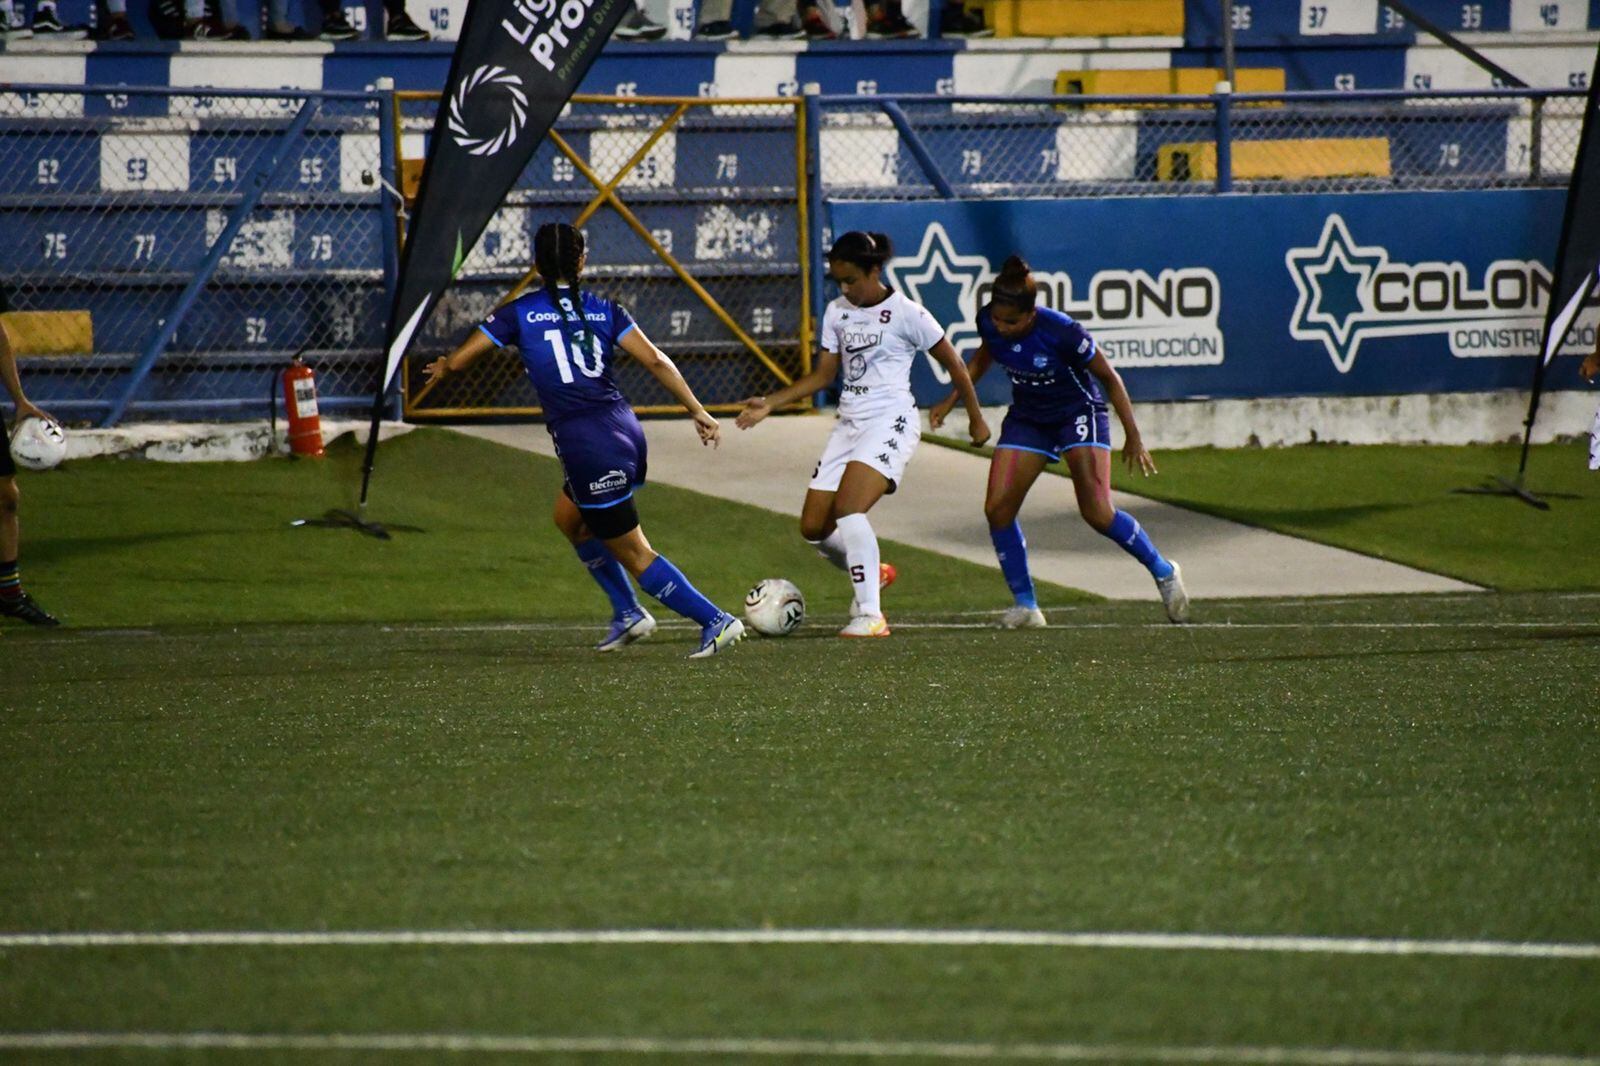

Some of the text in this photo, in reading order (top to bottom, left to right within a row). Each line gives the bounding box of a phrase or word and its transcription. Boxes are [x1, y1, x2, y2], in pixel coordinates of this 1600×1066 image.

[529, 0, 595, 72] Pro
[1308, 6, 1327, 29] 37
[544, 329, 605, 384] 10
[1076, 424, 1089, 442] 9
